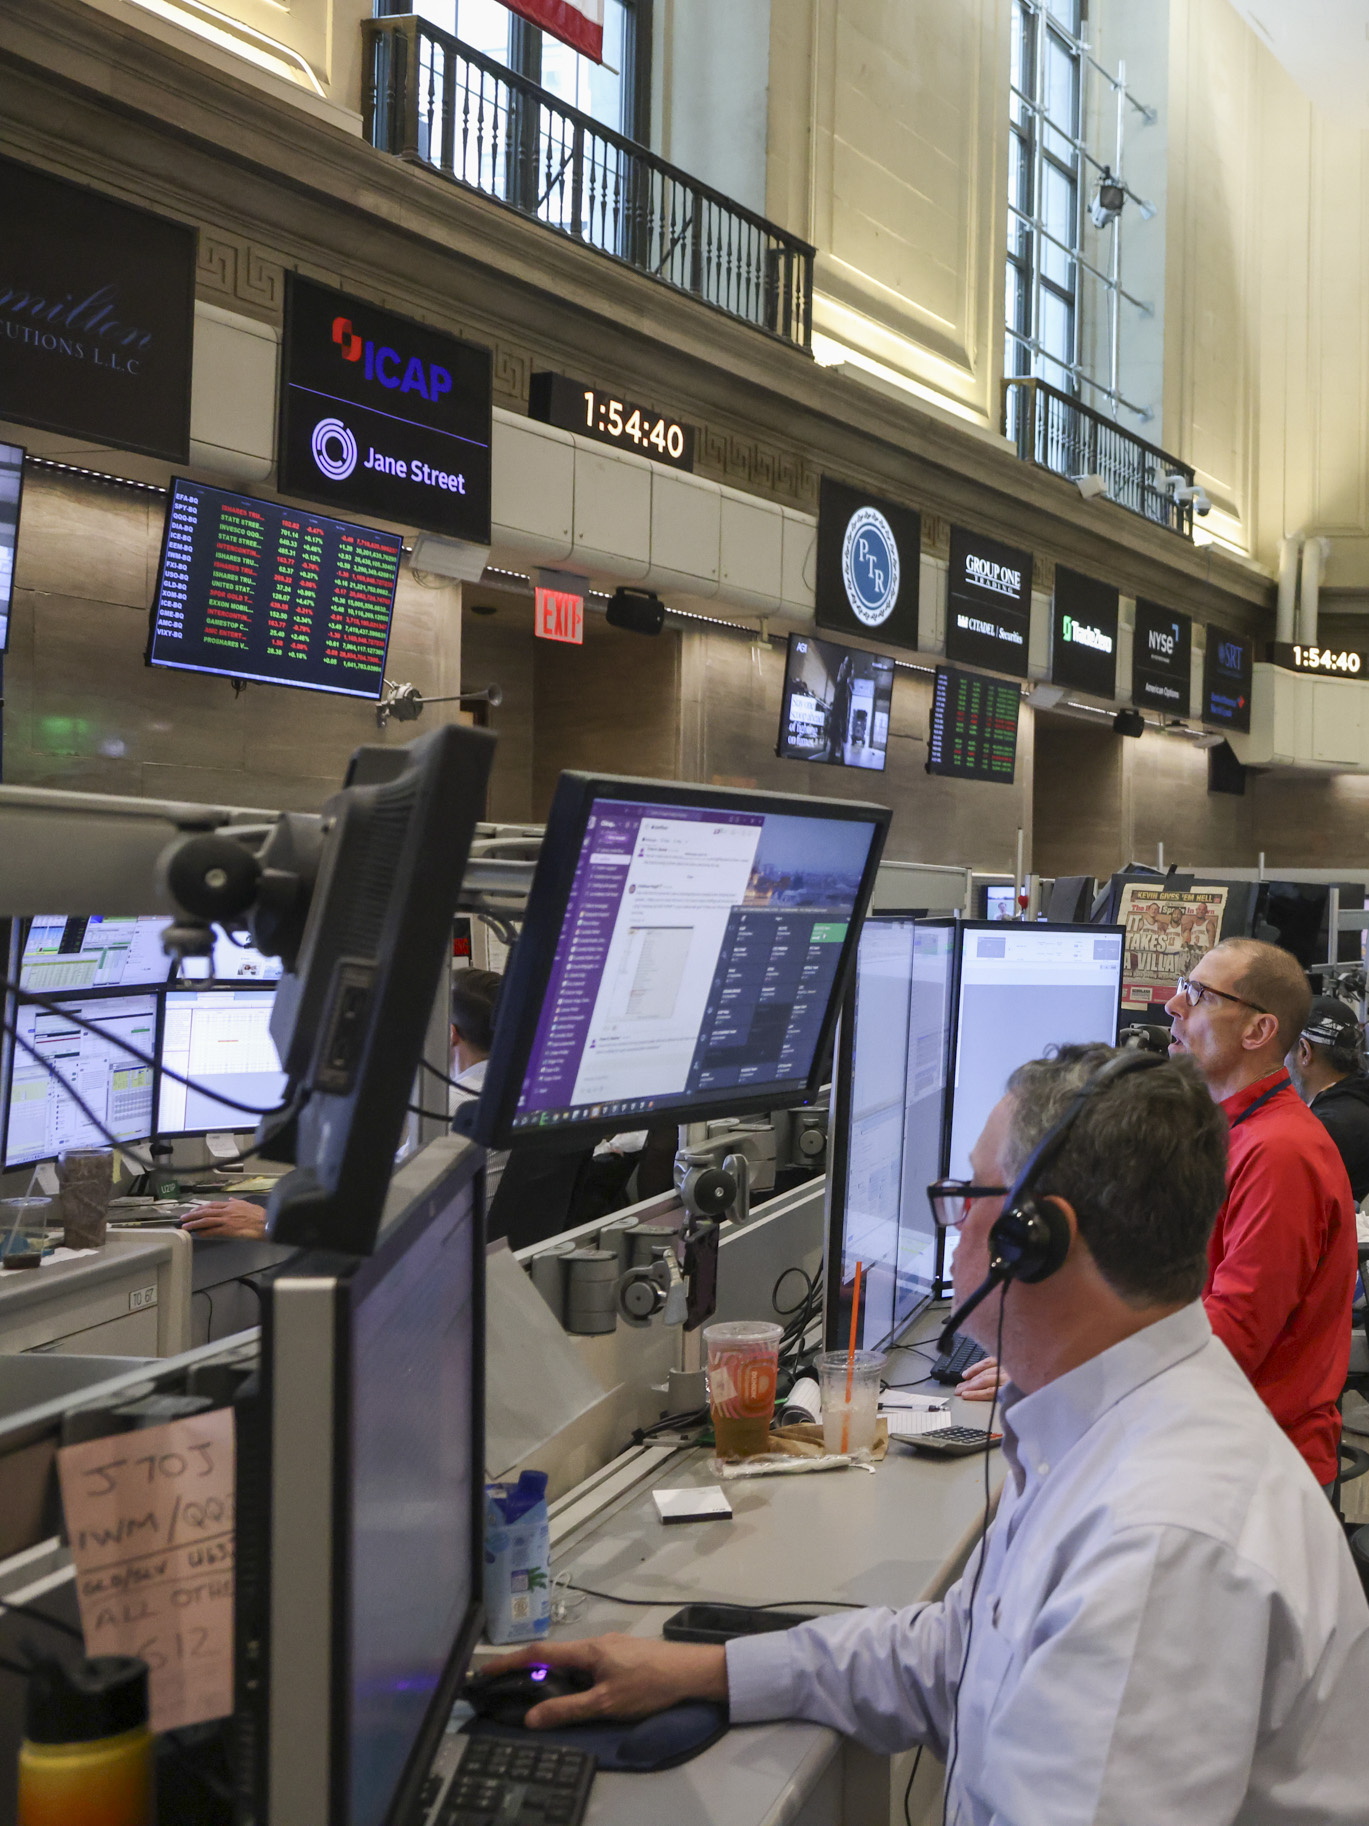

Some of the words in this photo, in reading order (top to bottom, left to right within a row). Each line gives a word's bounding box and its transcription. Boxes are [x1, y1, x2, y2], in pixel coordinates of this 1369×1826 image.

[0, 320, 84, 359] UTIONS
[364, 341, 453, 402] ICAP
[584, 391, 684, 459] 1:54:40
[364, 447, 407, 478] Jane
[411, 460, 466, 495] Street
[221, 514, 239, 524] STATE
[218, 533, 236, 542] STATE
[965, 554, 1000, 580] GROUP
[1000, 567, 1021, 586] ONE
[974, 575, 1013, 594] TRADING
[543, 591, 580, 640] EXIT
[968, 617, 995, 637] CITADEL
[1225, 642, 1243, 670] SRT
[1293, 645, 1361, 673] 1:54:40
[1145, 682, 1164, 695] American
[1163, 686, 1180, 699] Options
[1137, 891, 1158, 900] KEVIN
[1160, 892, 1179, 901] GIVES
[1196, 894, 1212, 902] HELL
[1127, 914, 1143, 932] IT
[1125, 932, 1168, 952] TAKES
